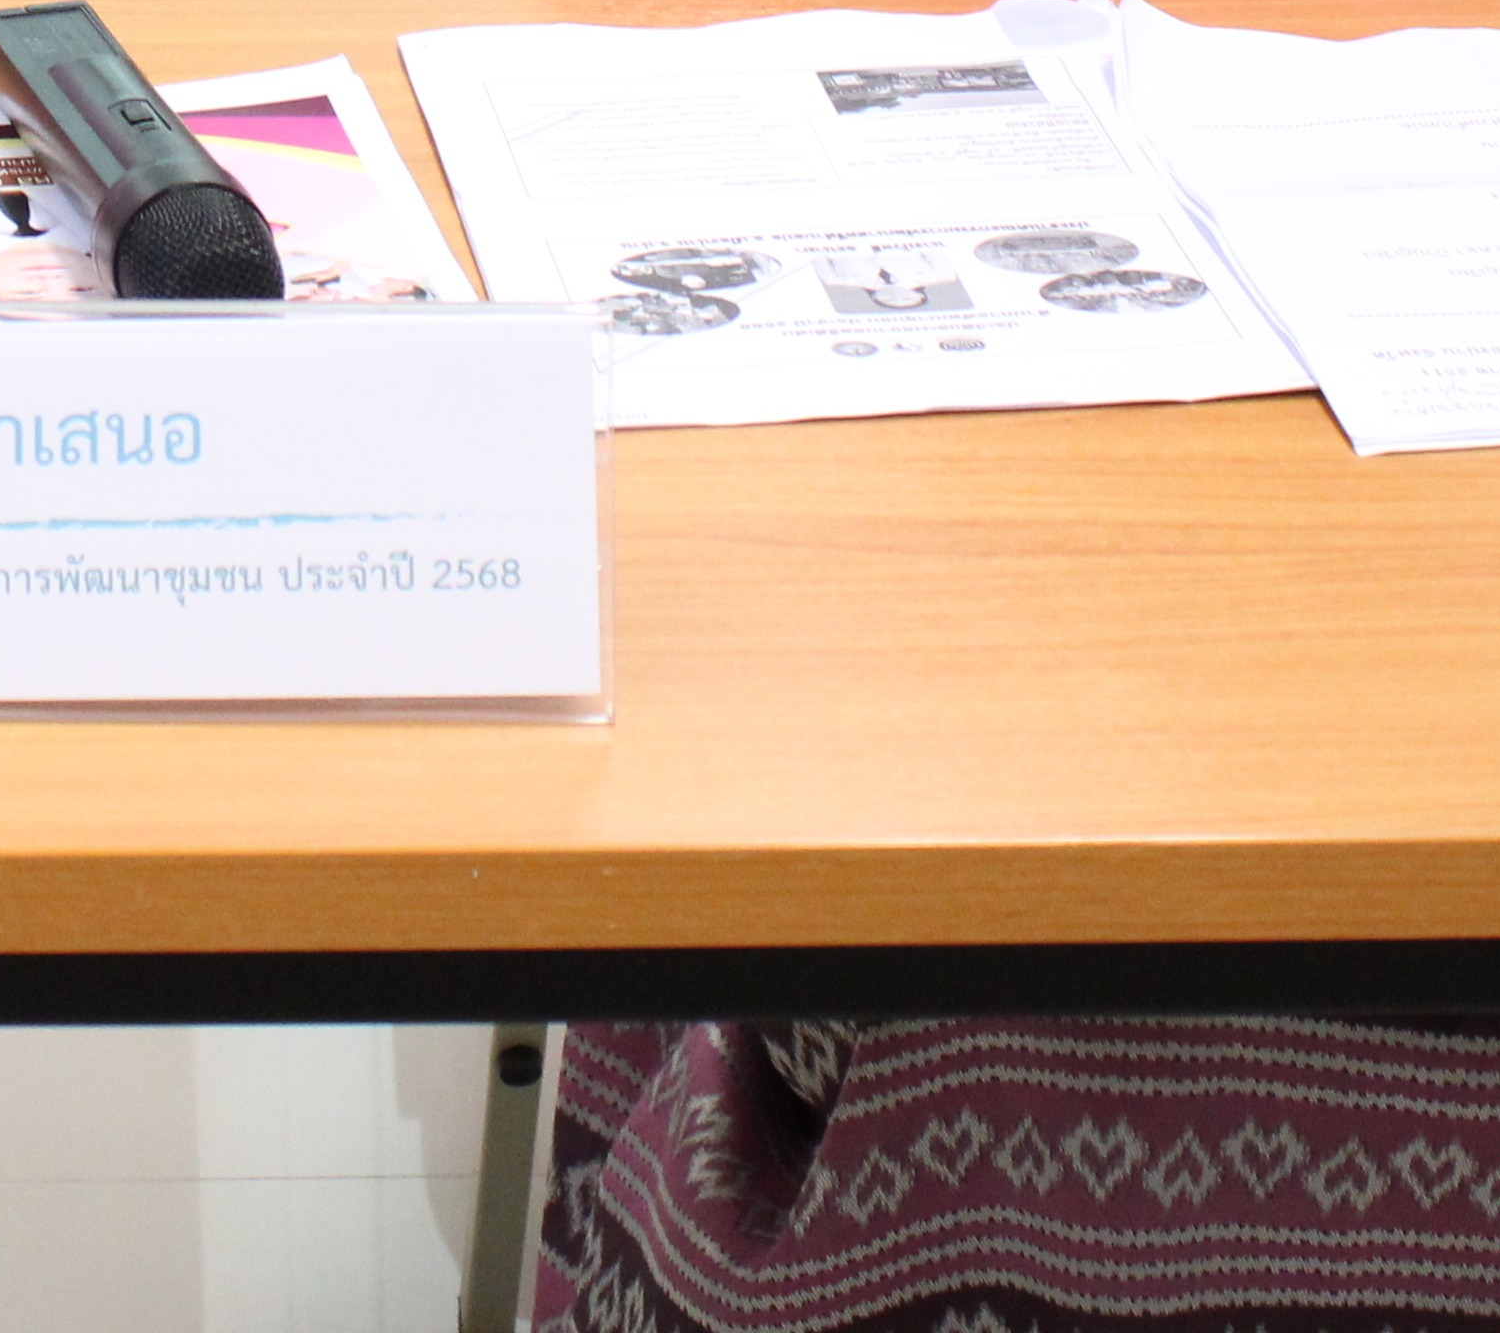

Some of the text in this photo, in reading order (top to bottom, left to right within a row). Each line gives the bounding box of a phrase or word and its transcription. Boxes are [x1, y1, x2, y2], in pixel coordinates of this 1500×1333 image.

[279, 549, 417, 593] ประจำปี
[432, 558, 523, 592] 2568
